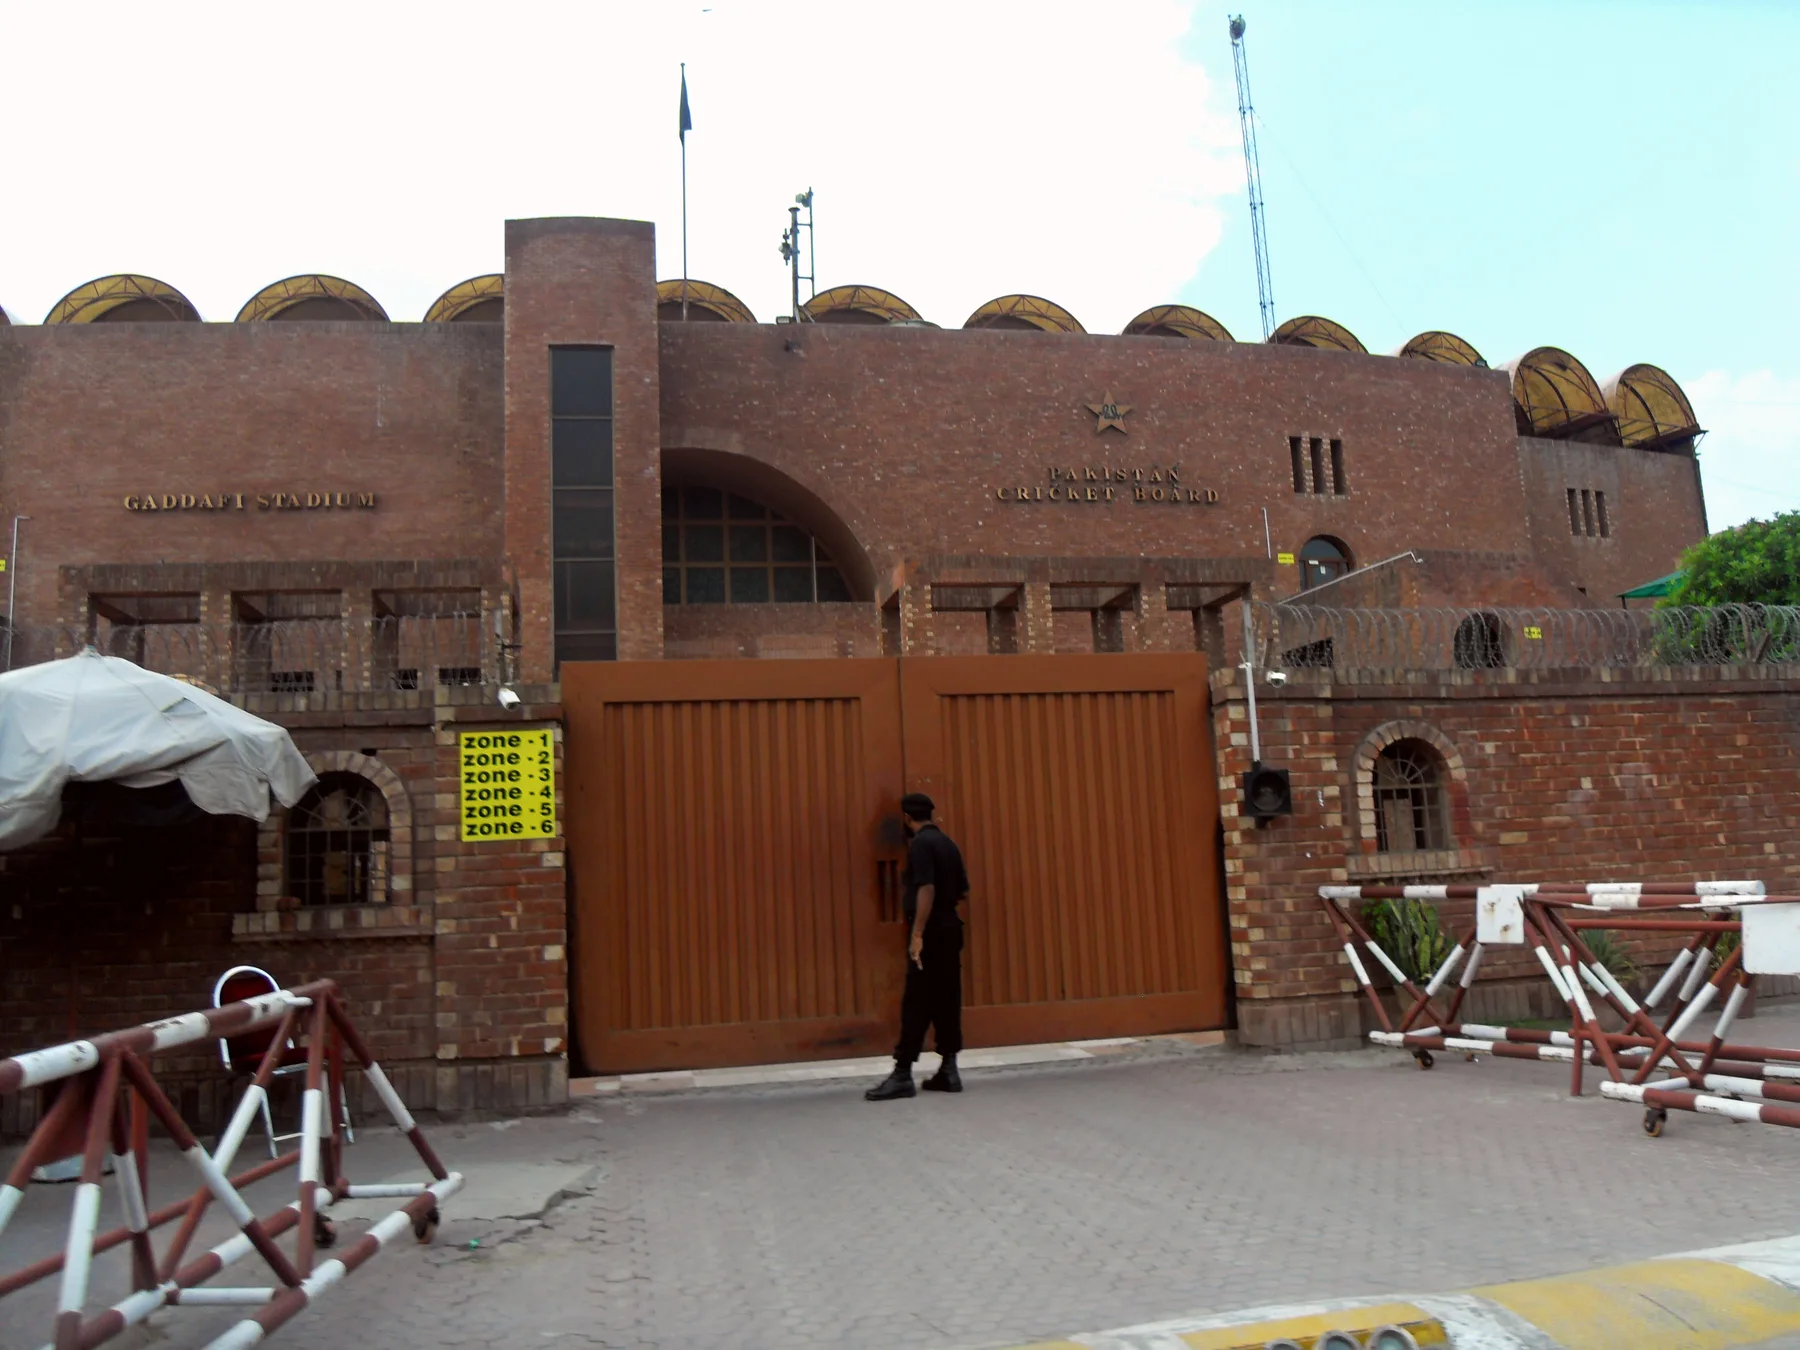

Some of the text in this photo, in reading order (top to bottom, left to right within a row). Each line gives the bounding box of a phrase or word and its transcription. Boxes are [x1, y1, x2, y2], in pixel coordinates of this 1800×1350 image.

[1049, 466, 1180, 482] PAKISTAN
[124, 491, 375, 510] GADDAFI STADIUM
[996, 486, 1220, 503] CRICKET BOARD
[464, 735, 521, 749] zone
[539, 733, 548, 747] 1
[464, 752, 521, 766] zone
[538, 751, 550, 764] 2
[464, 769, 521, 783] zone
[538, 768, 551, 781] 3
[465, 787, 522, 801] zone
[539, 785, 552, 799] 4
[465, 804, 522, 818] zone
[540, 802, 552, 816] 5
[466, 821, 524, 836] zone
[541, 820, 553, 833] 6
